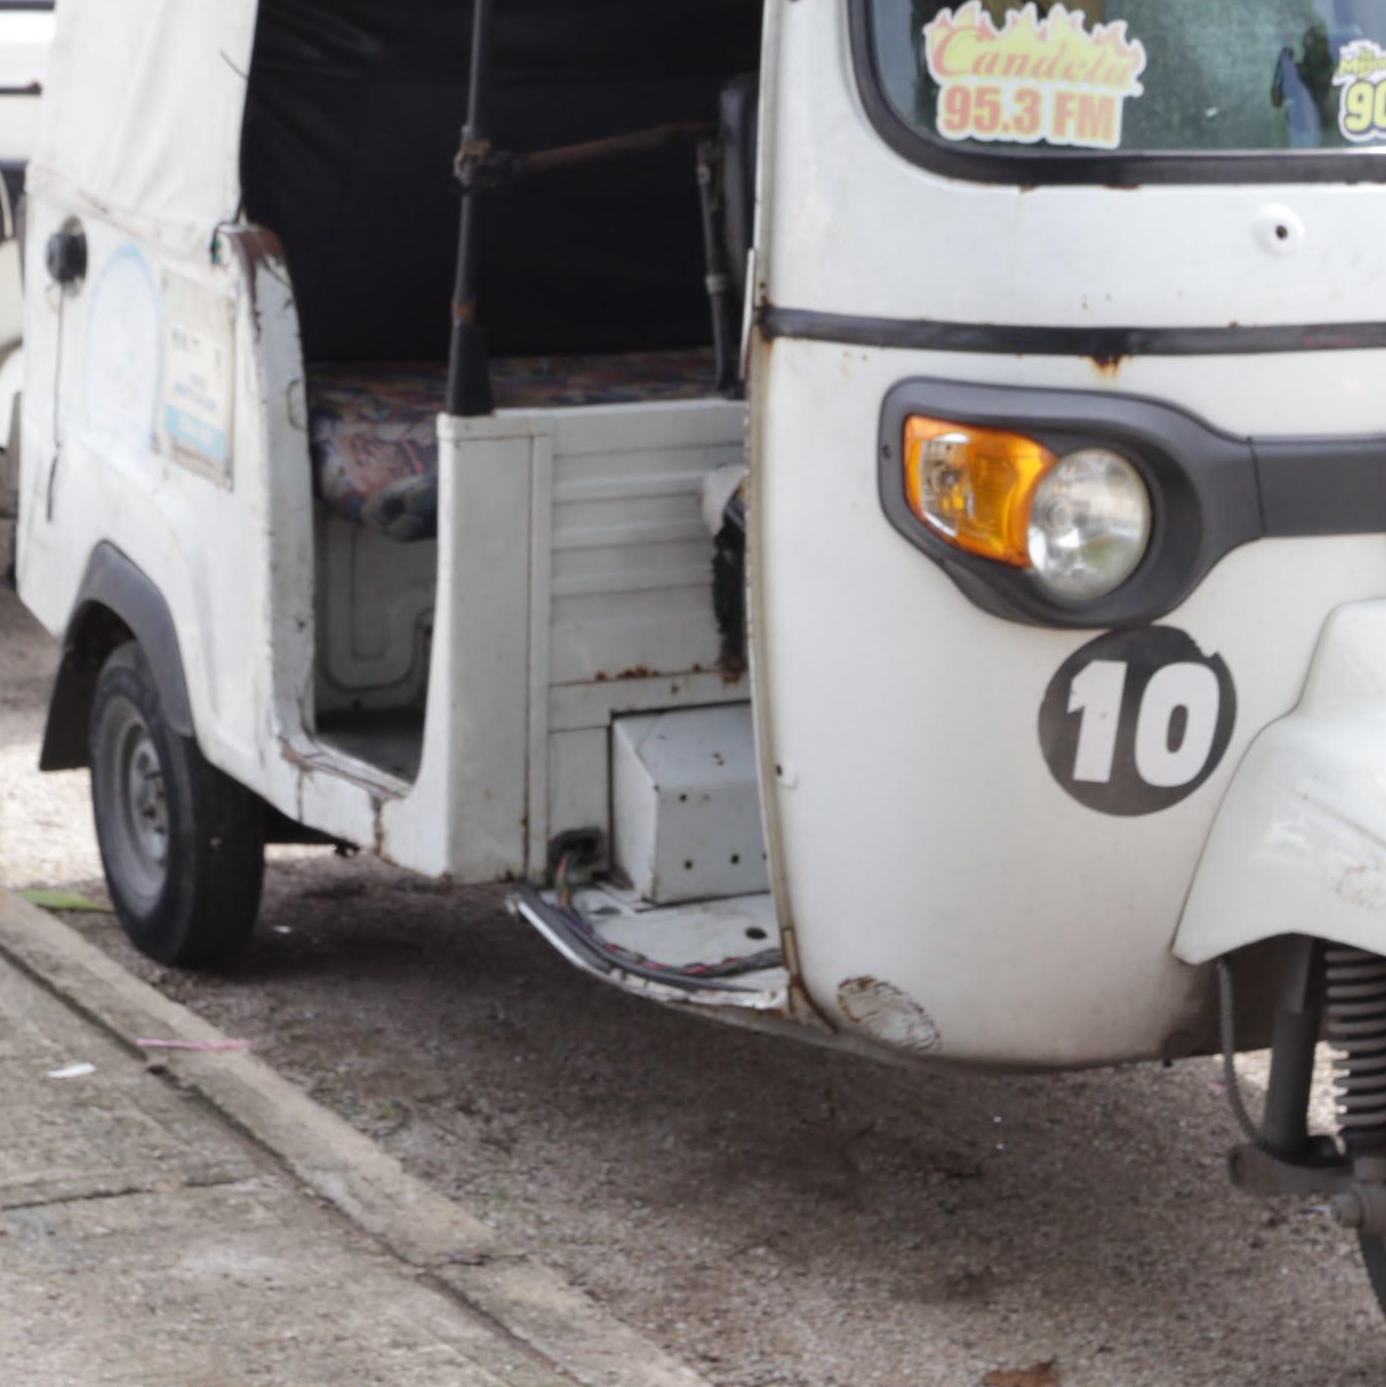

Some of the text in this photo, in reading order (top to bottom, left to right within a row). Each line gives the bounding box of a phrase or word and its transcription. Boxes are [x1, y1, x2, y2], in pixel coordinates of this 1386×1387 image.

[933, 24, 1132, 86] Candela
[944, 86, 1116, 140] 95.3 FM
[1067, 660, 1220, 787] 10
